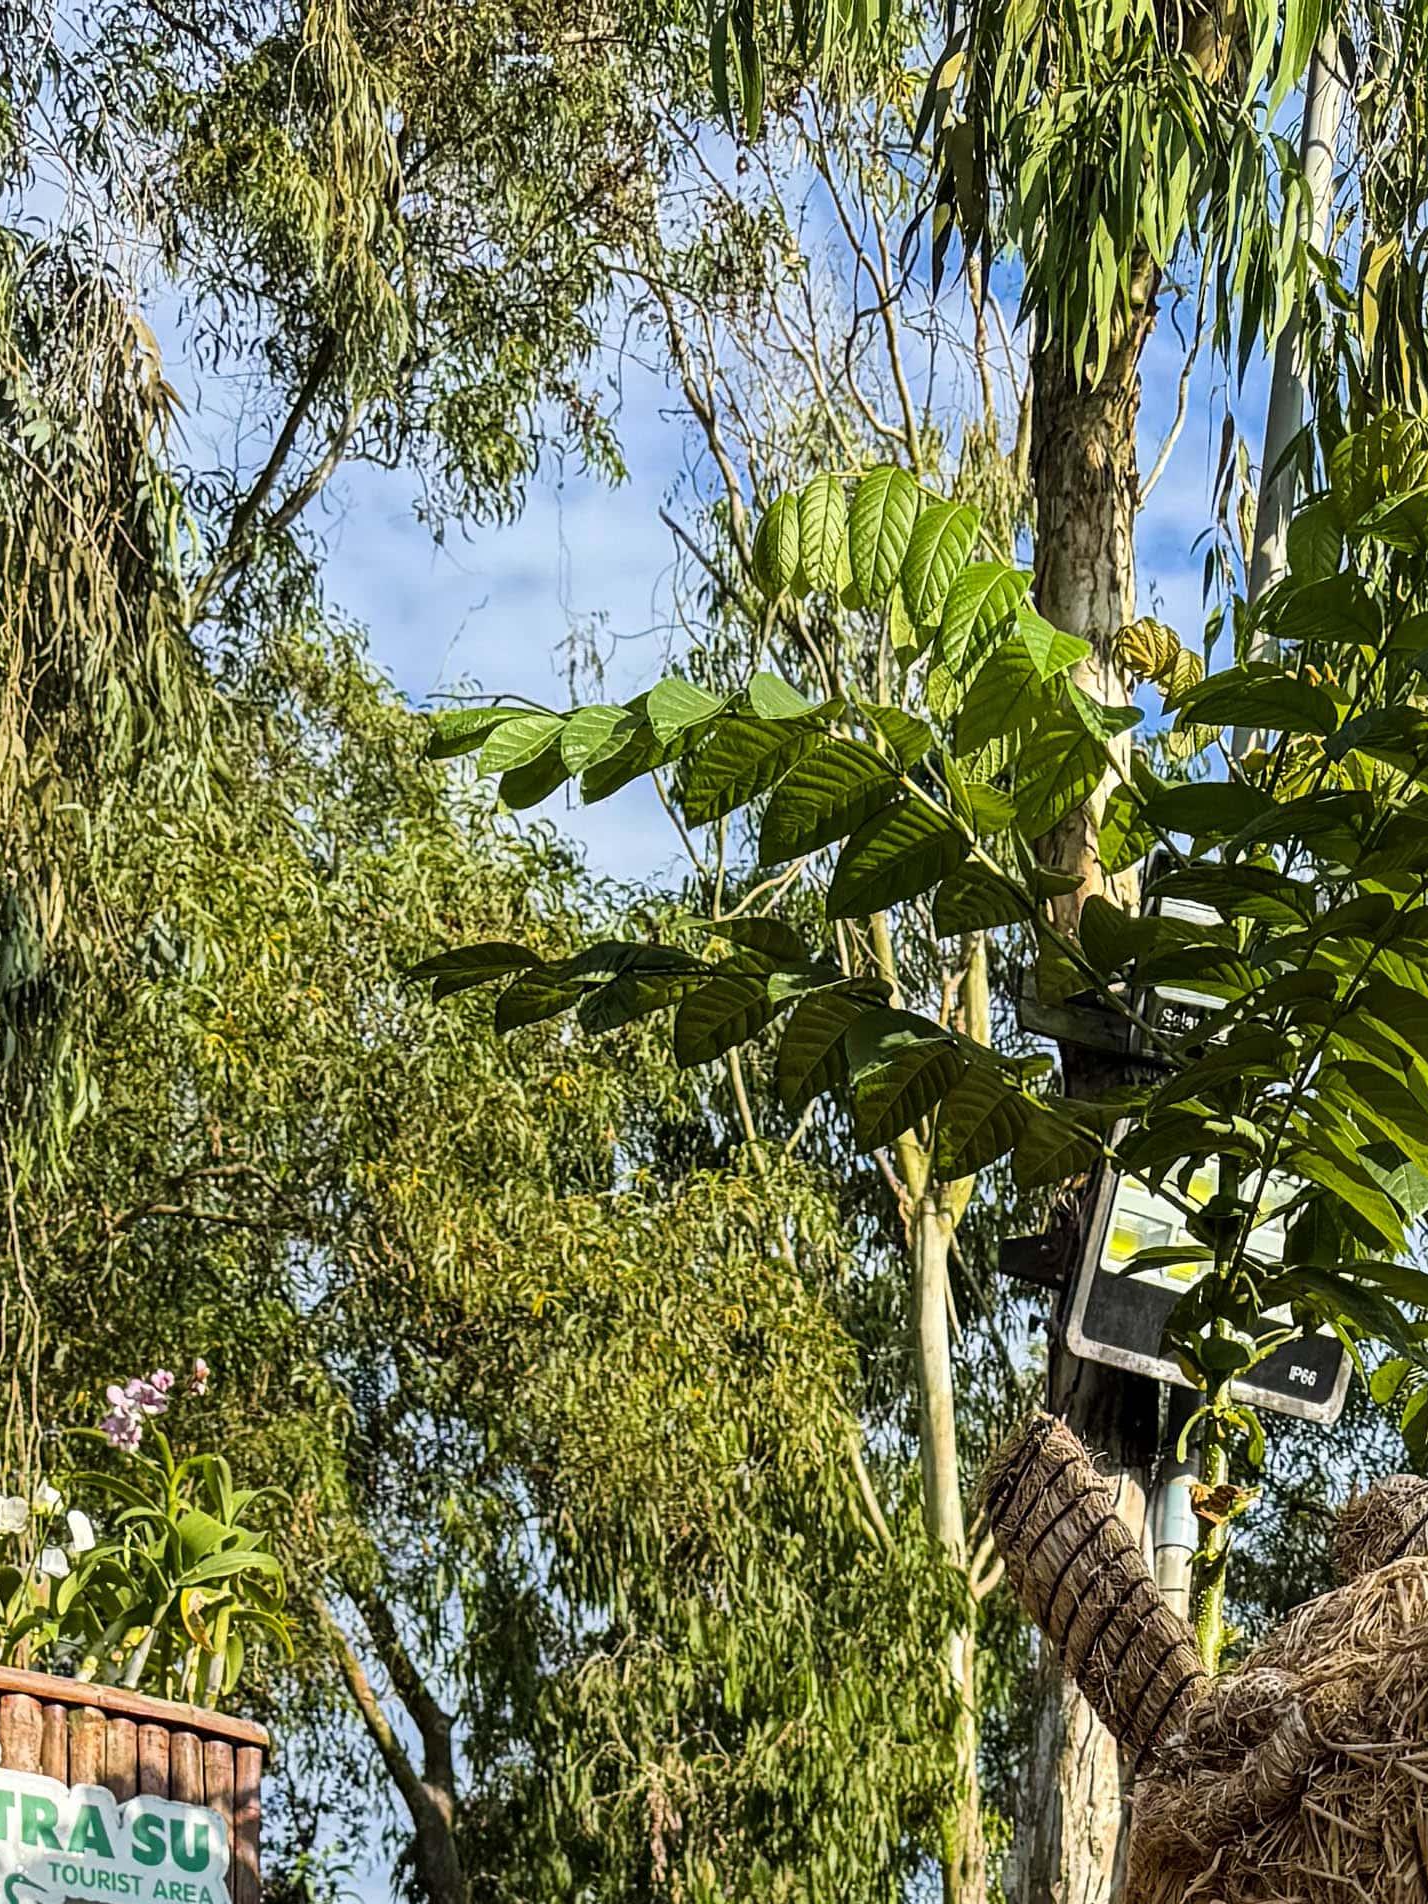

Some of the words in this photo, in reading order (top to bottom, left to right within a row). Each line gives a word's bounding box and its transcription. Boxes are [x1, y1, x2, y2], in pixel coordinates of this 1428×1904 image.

[1288, 1365, 1317, 1387] IP66
[132, 1813, 210, 1872] SU
[48, 1862, 142, 1897] TOURIST
